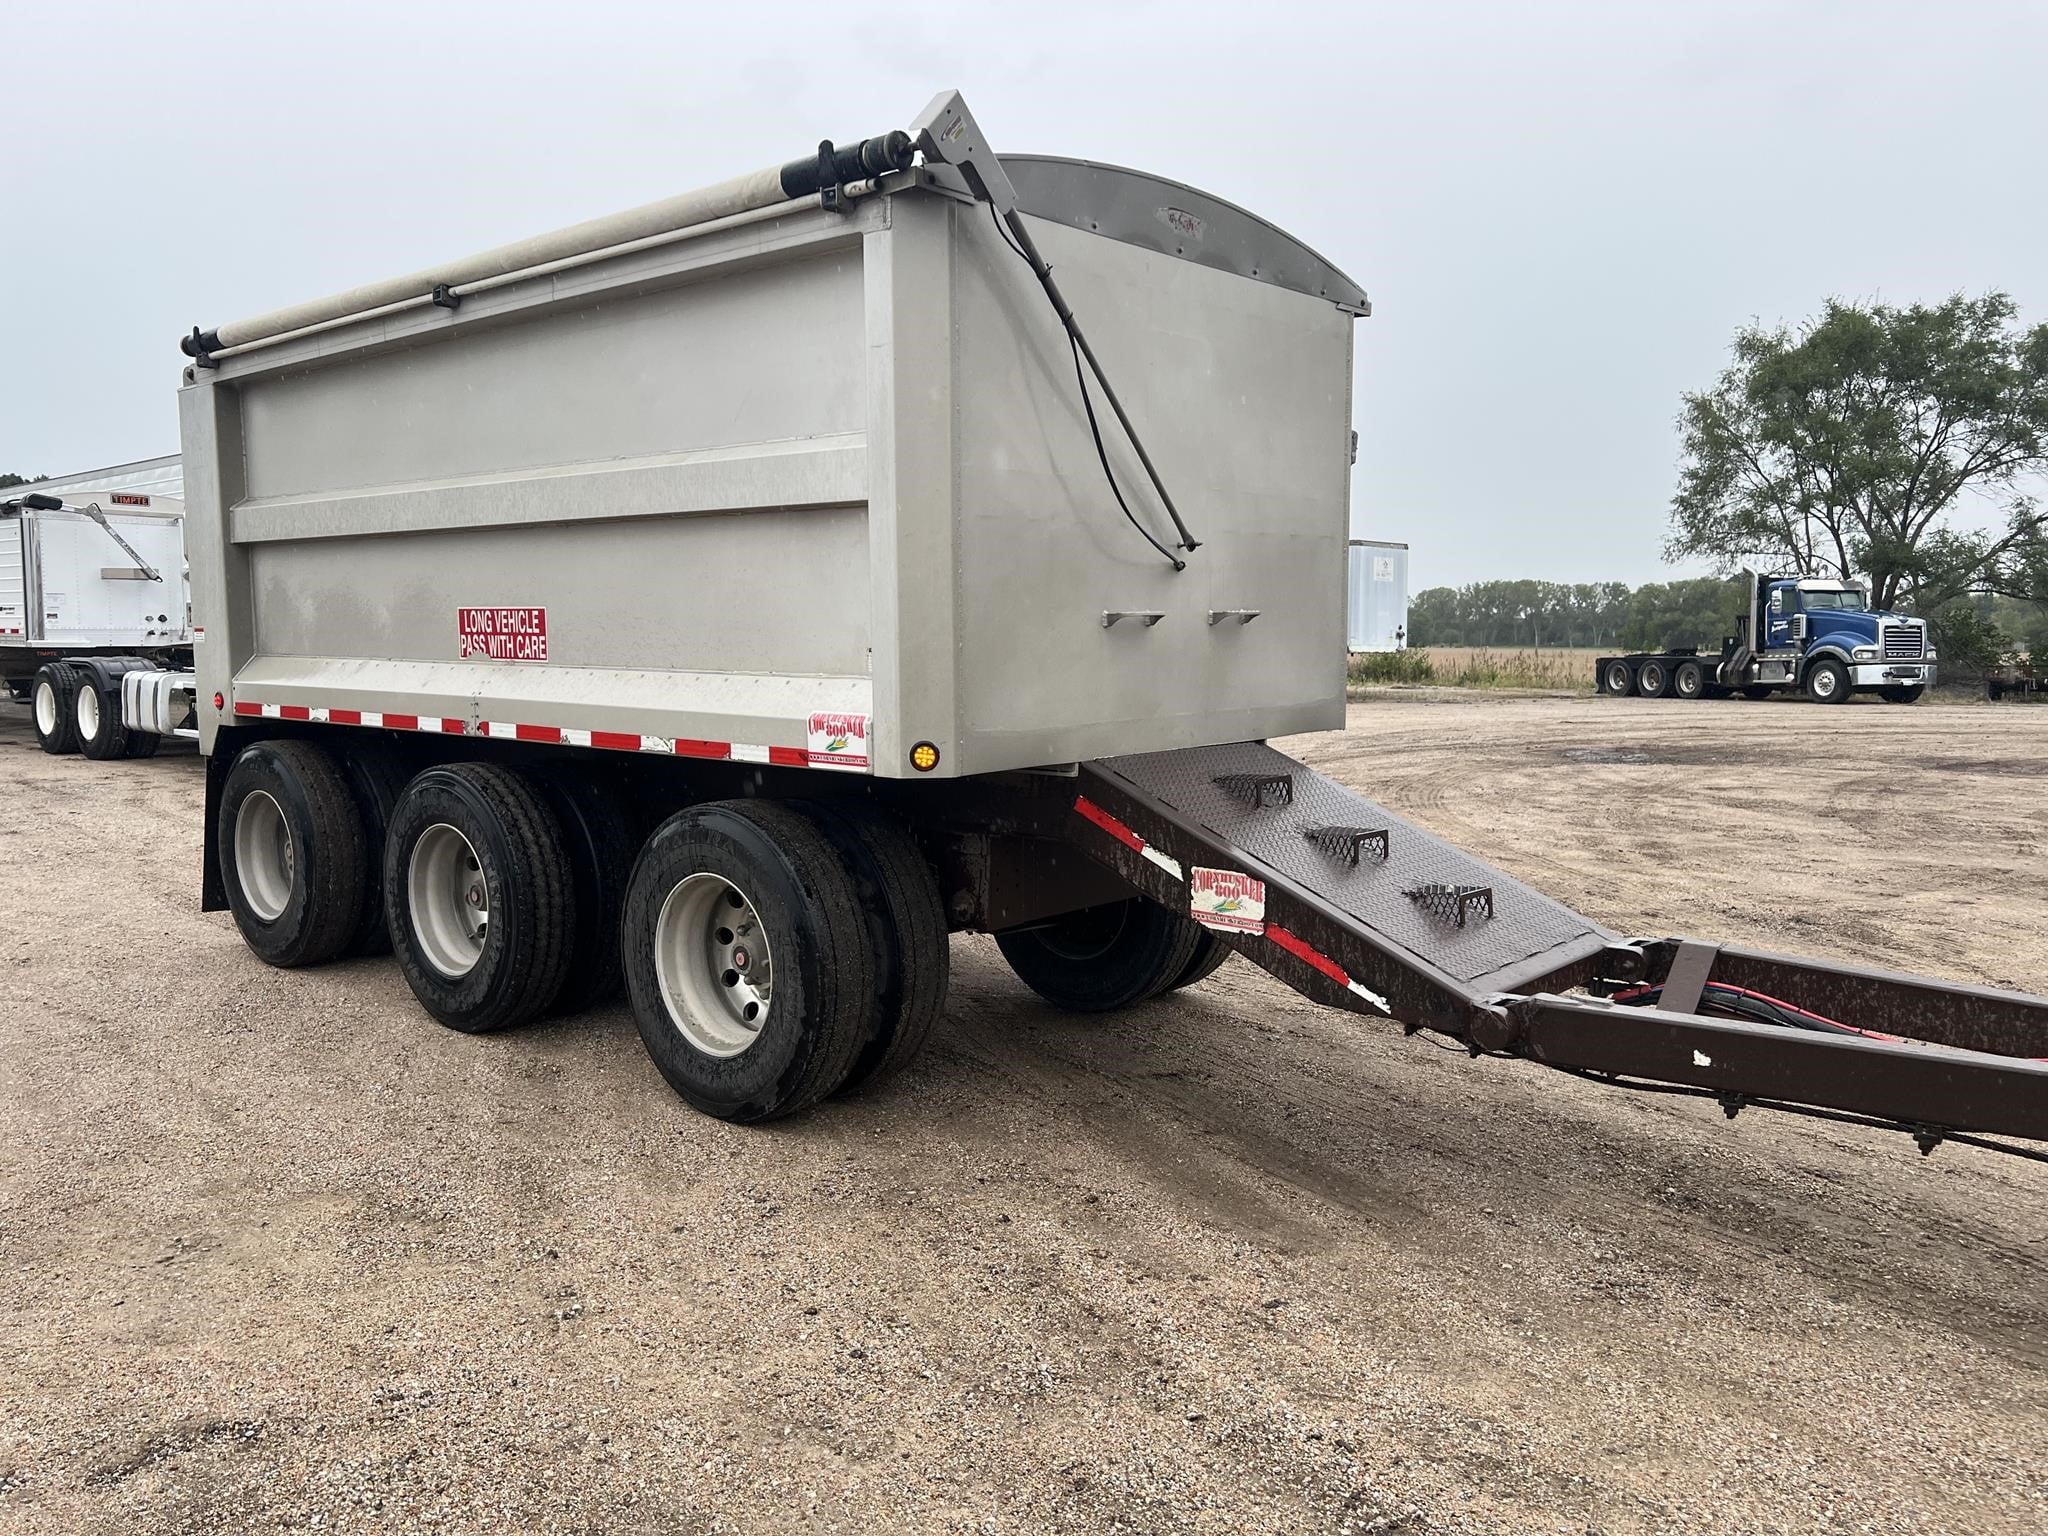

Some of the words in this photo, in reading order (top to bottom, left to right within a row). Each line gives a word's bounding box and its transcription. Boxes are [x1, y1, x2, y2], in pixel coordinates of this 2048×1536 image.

[113, 496, 149, 505] TIMPTE
[464, 610, 492, 633] LONG
[494, 610, 540, 633] VEHICLE
[461, 634, 486, 656] PASS
[488, 635, 514, 658] WITH
[516, 636, 546, 659] CARE
[826, 724, 846, 738] 800
[1193, 869, 1263, 903] CORNHUSKER
[1215, 885, 1240, 900] 800
